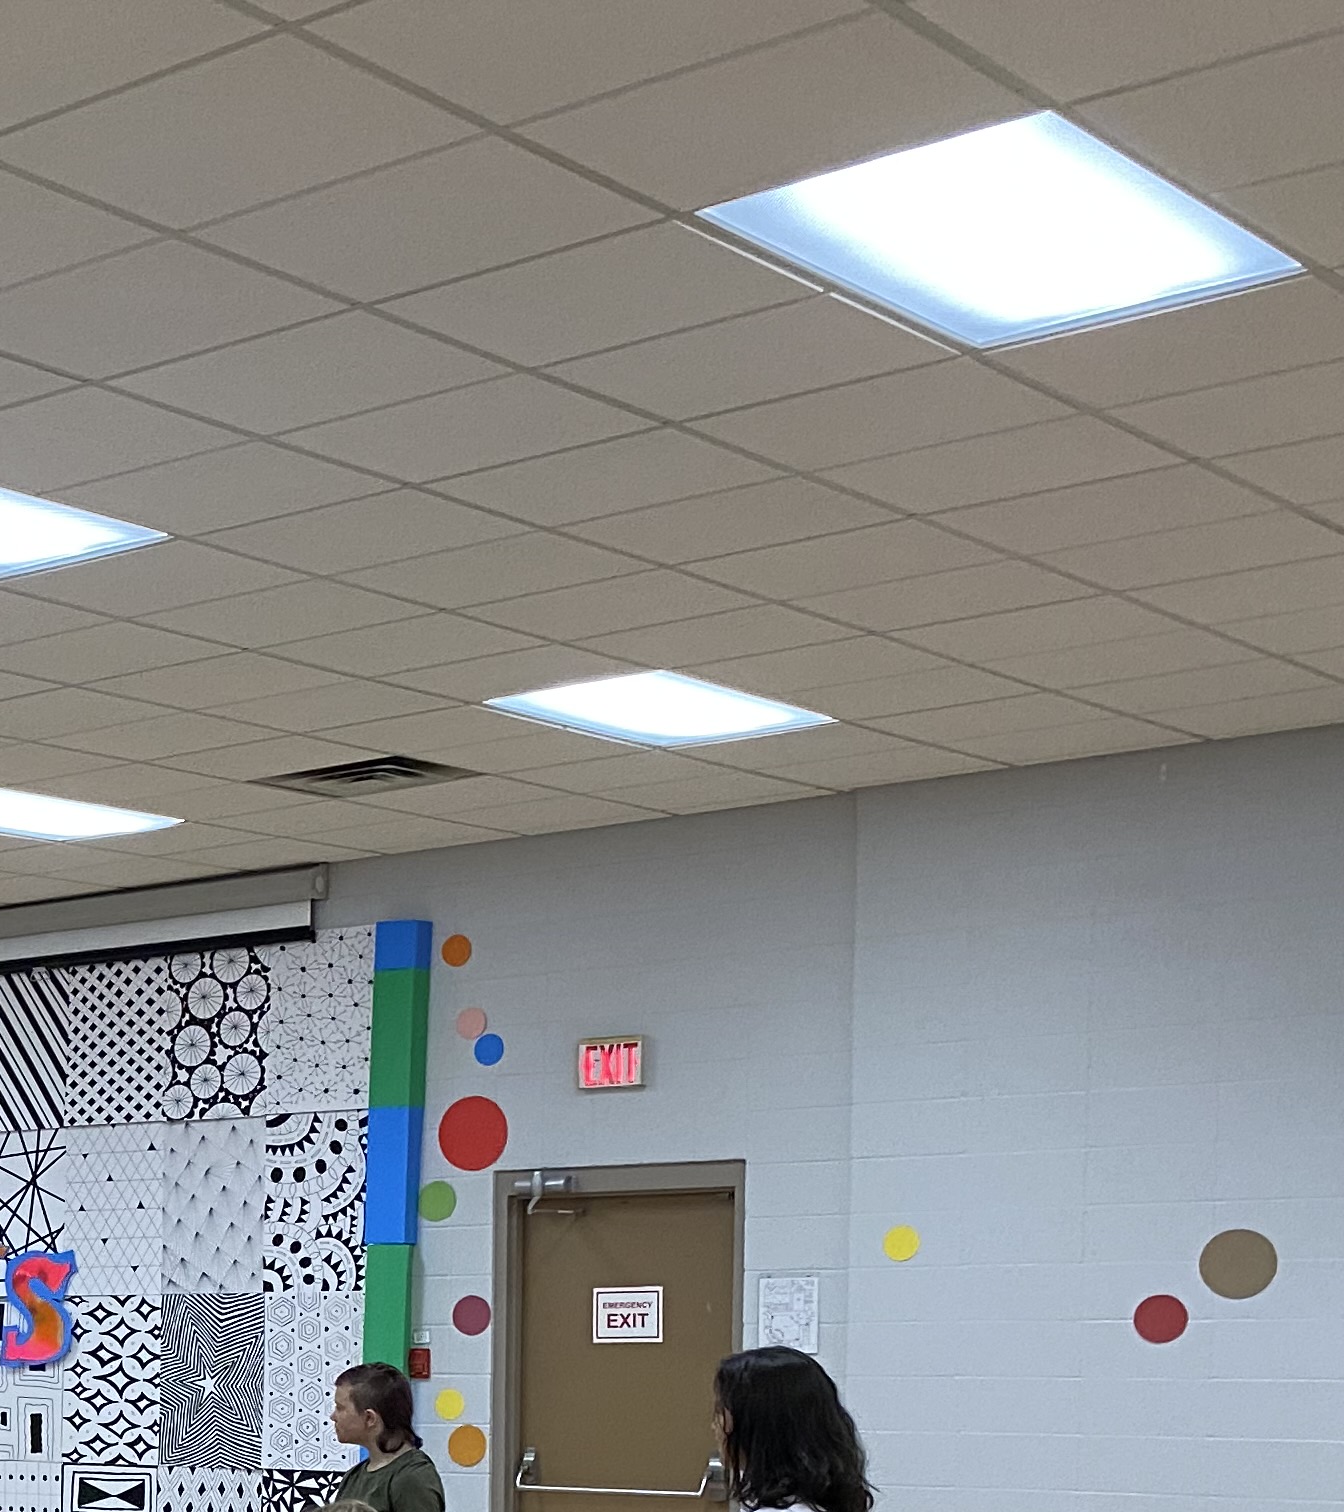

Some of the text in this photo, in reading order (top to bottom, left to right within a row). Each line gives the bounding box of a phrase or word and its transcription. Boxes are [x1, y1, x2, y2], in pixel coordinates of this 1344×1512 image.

[584, 1042, 638, 1086] EXIT
[602, 1301, 654, 1309] EMERGENCY
[607, 1313, 649, 1328] EXIT
